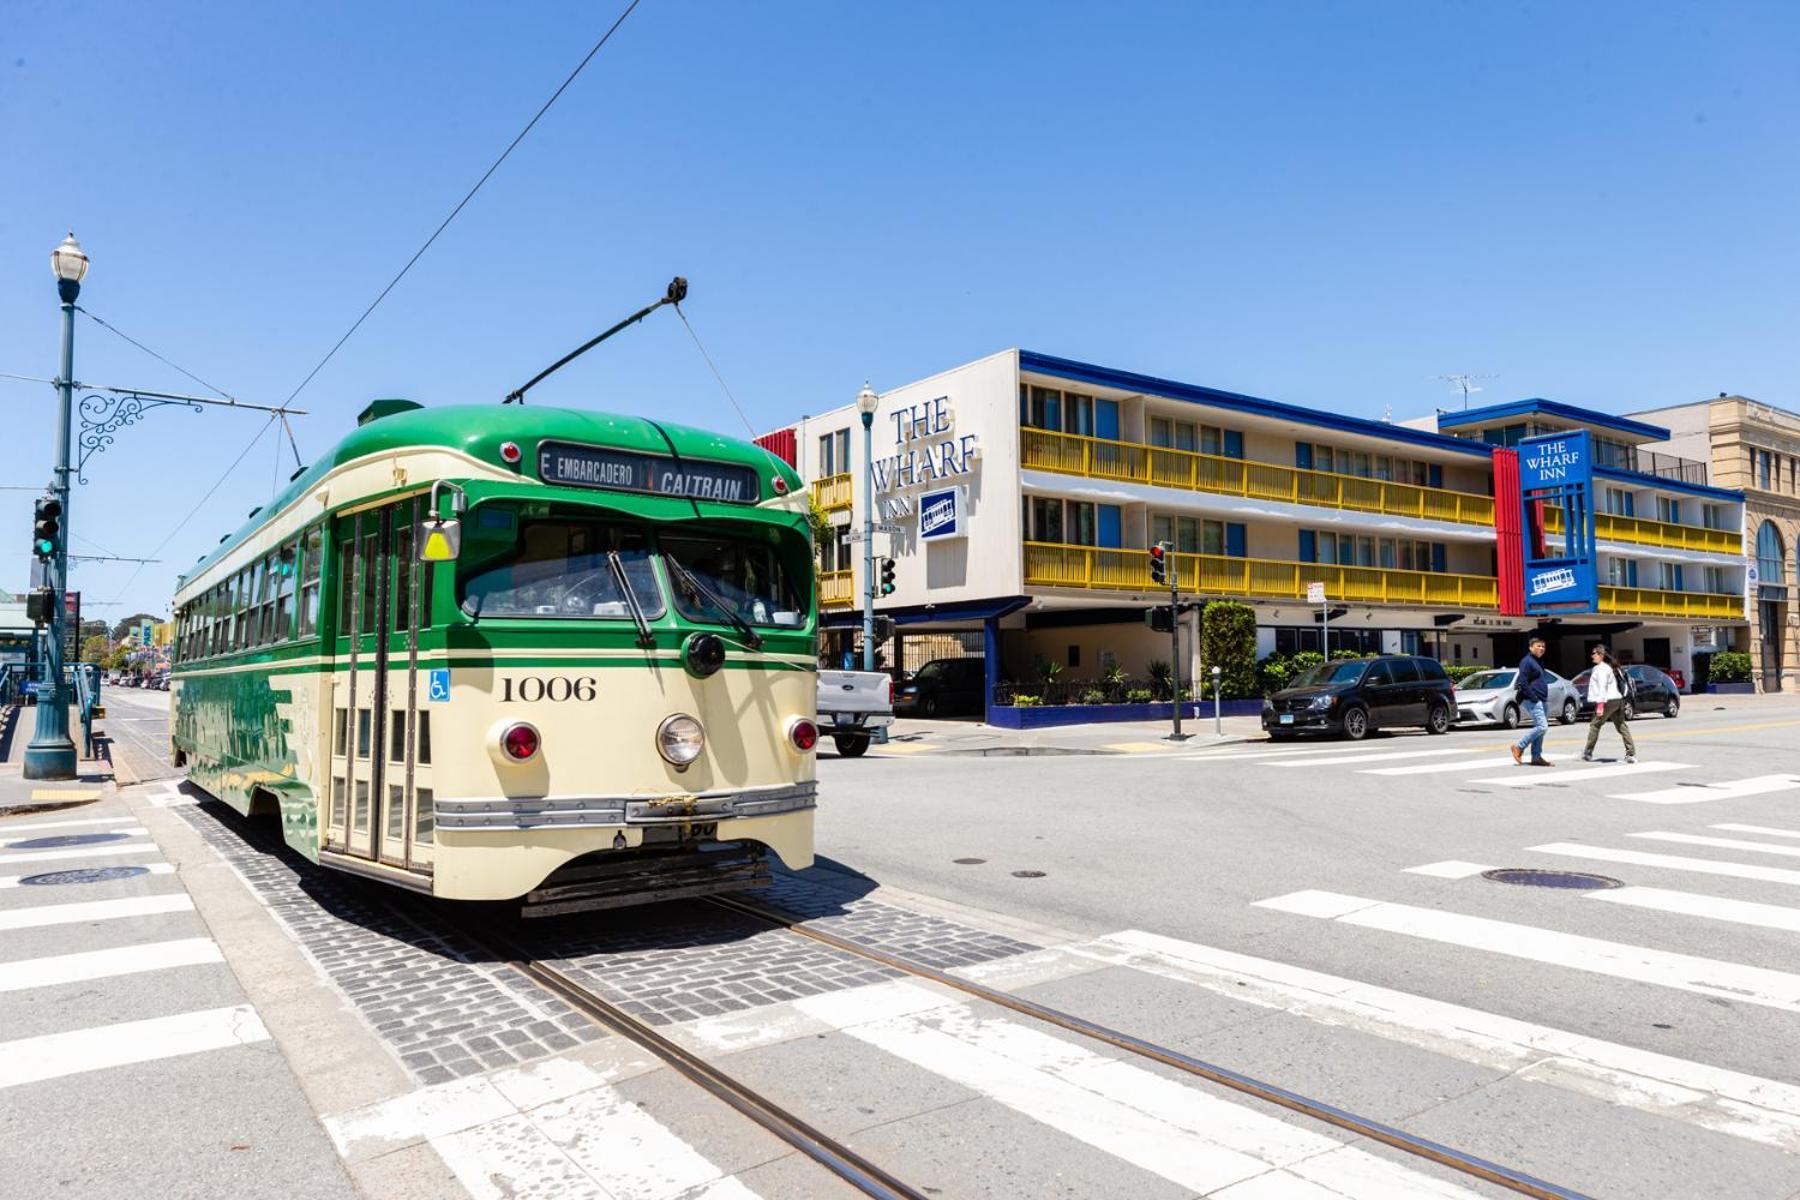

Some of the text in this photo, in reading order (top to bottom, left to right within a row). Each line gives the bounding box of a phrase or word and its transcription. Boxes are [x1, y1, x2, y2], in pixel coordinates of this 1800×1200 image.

[890, 395, 951, 444] THE
[1526, 451, 1580, 470] WHARF
[1536, 440, 1567, 456] THE
[540, 452, 633, 486] E EMBARCADERO
[871, 434, 977, 493] WHARF
[1540, 466, 1567, 481] INN
[660, 471, 742, 501] CALTRAIN
[882, 495, 912, 520] INN
[877, 524, 902, 533] MASON
[498, 676, 597, 703] 1006
